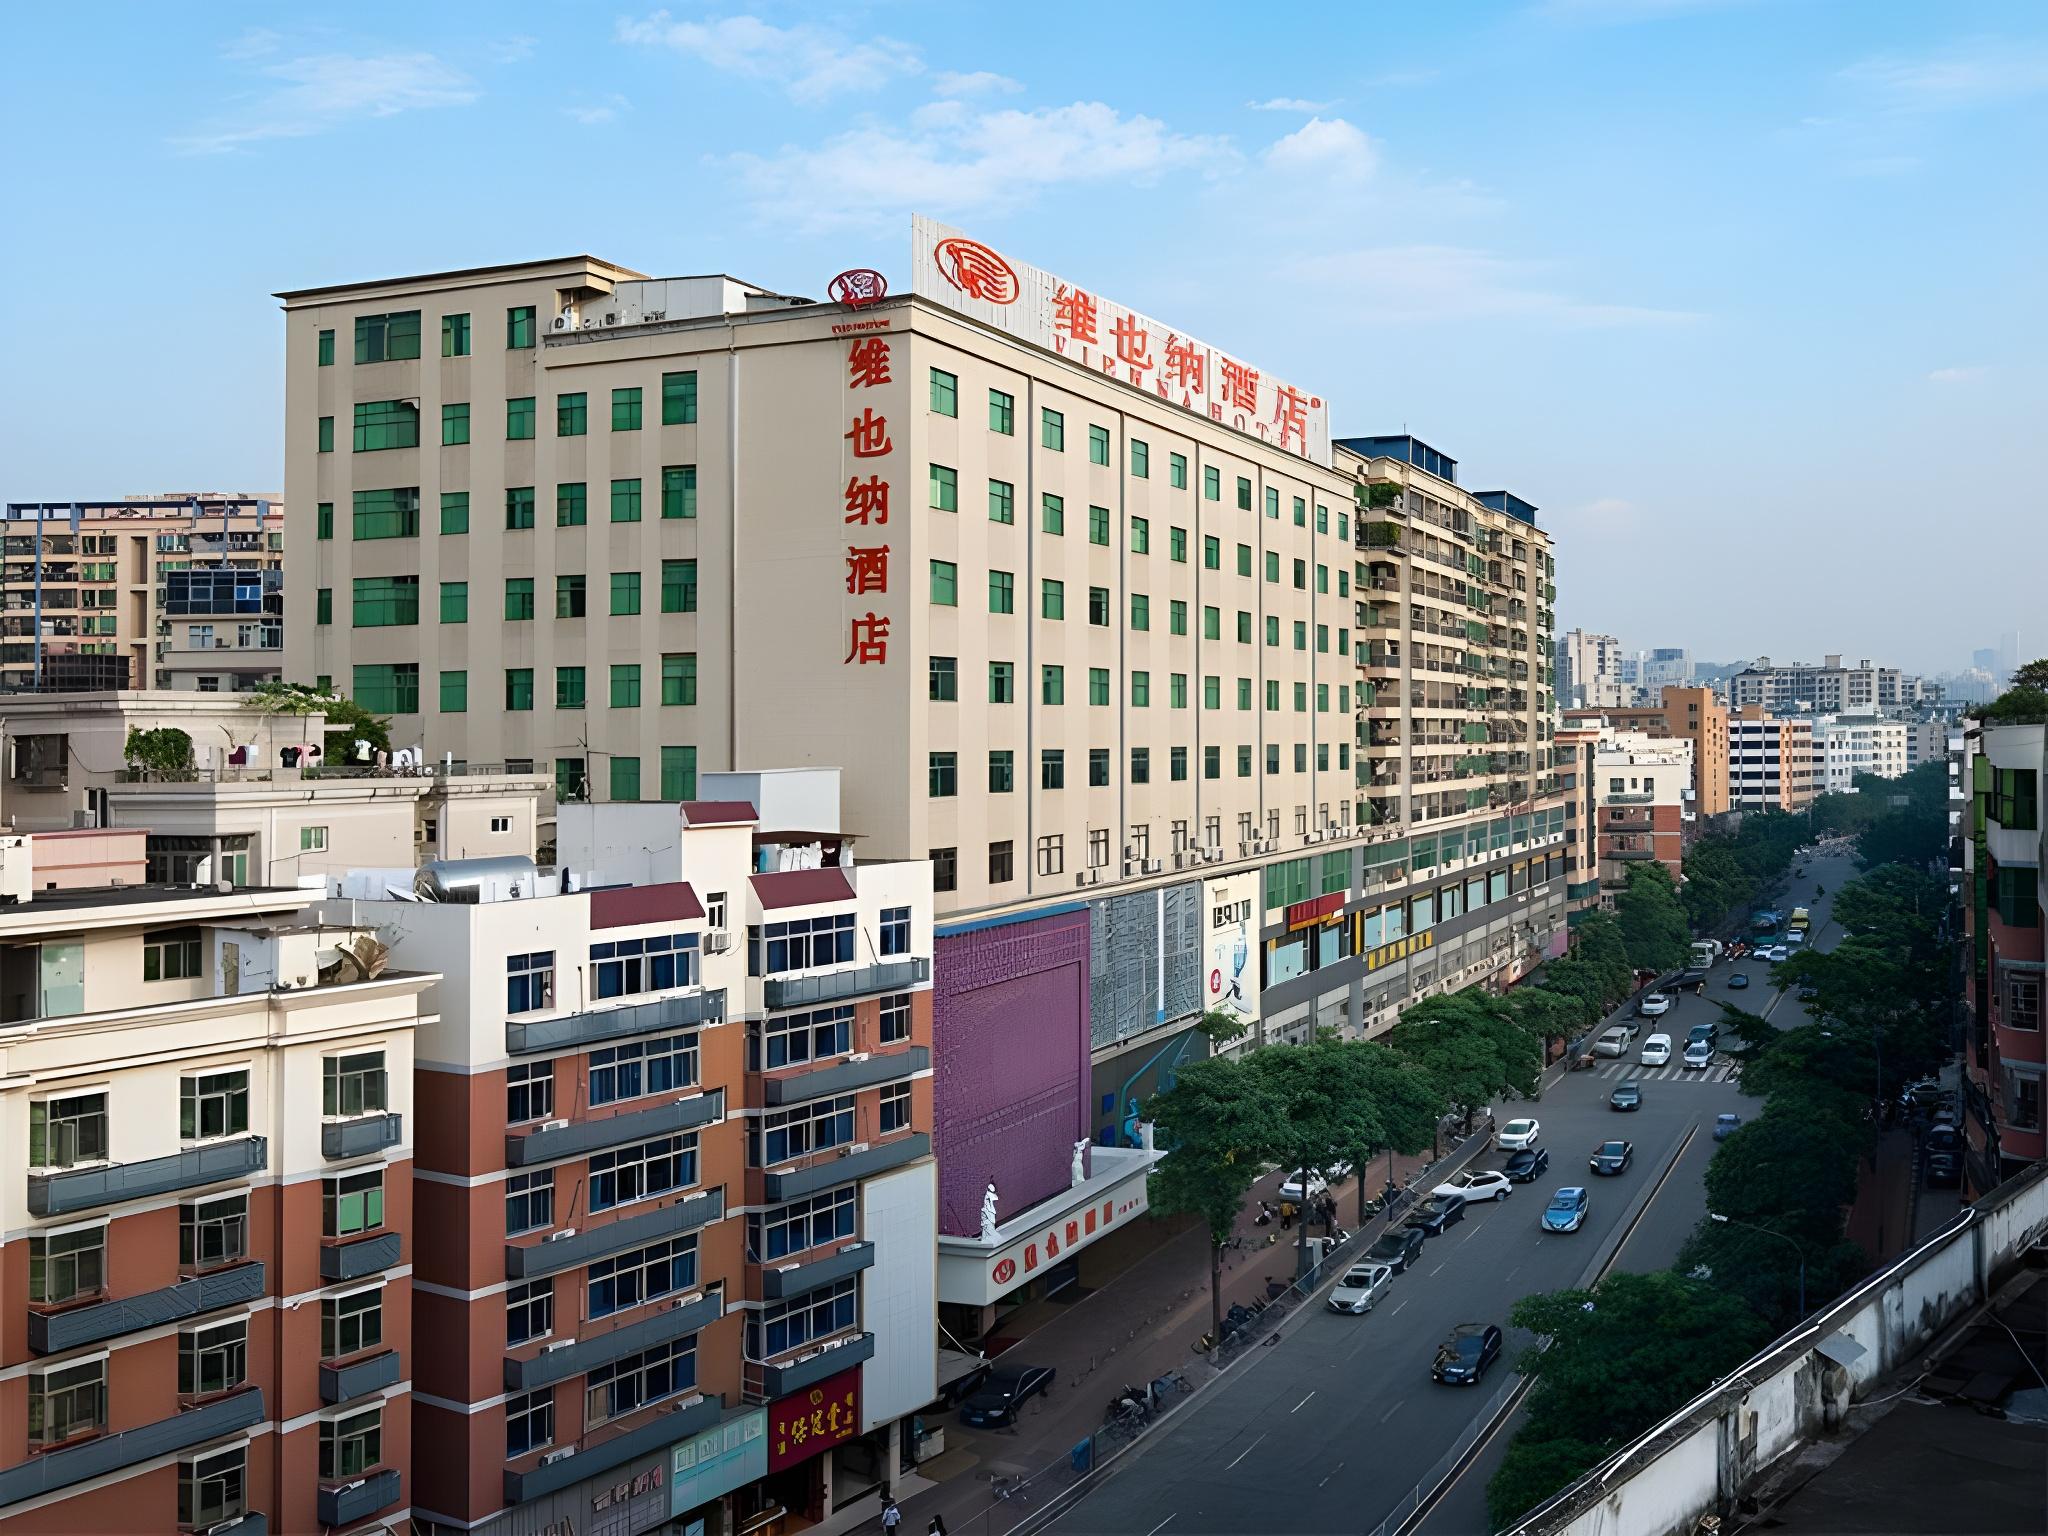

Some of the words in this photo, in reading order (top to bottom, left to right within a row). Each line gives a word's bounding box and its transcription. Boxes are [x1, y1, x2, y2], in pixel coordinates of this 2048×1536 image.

[1052, 283, 1308, 458] 维也纳酒店
[844, 338, 893, 665] 维也纳酒店
